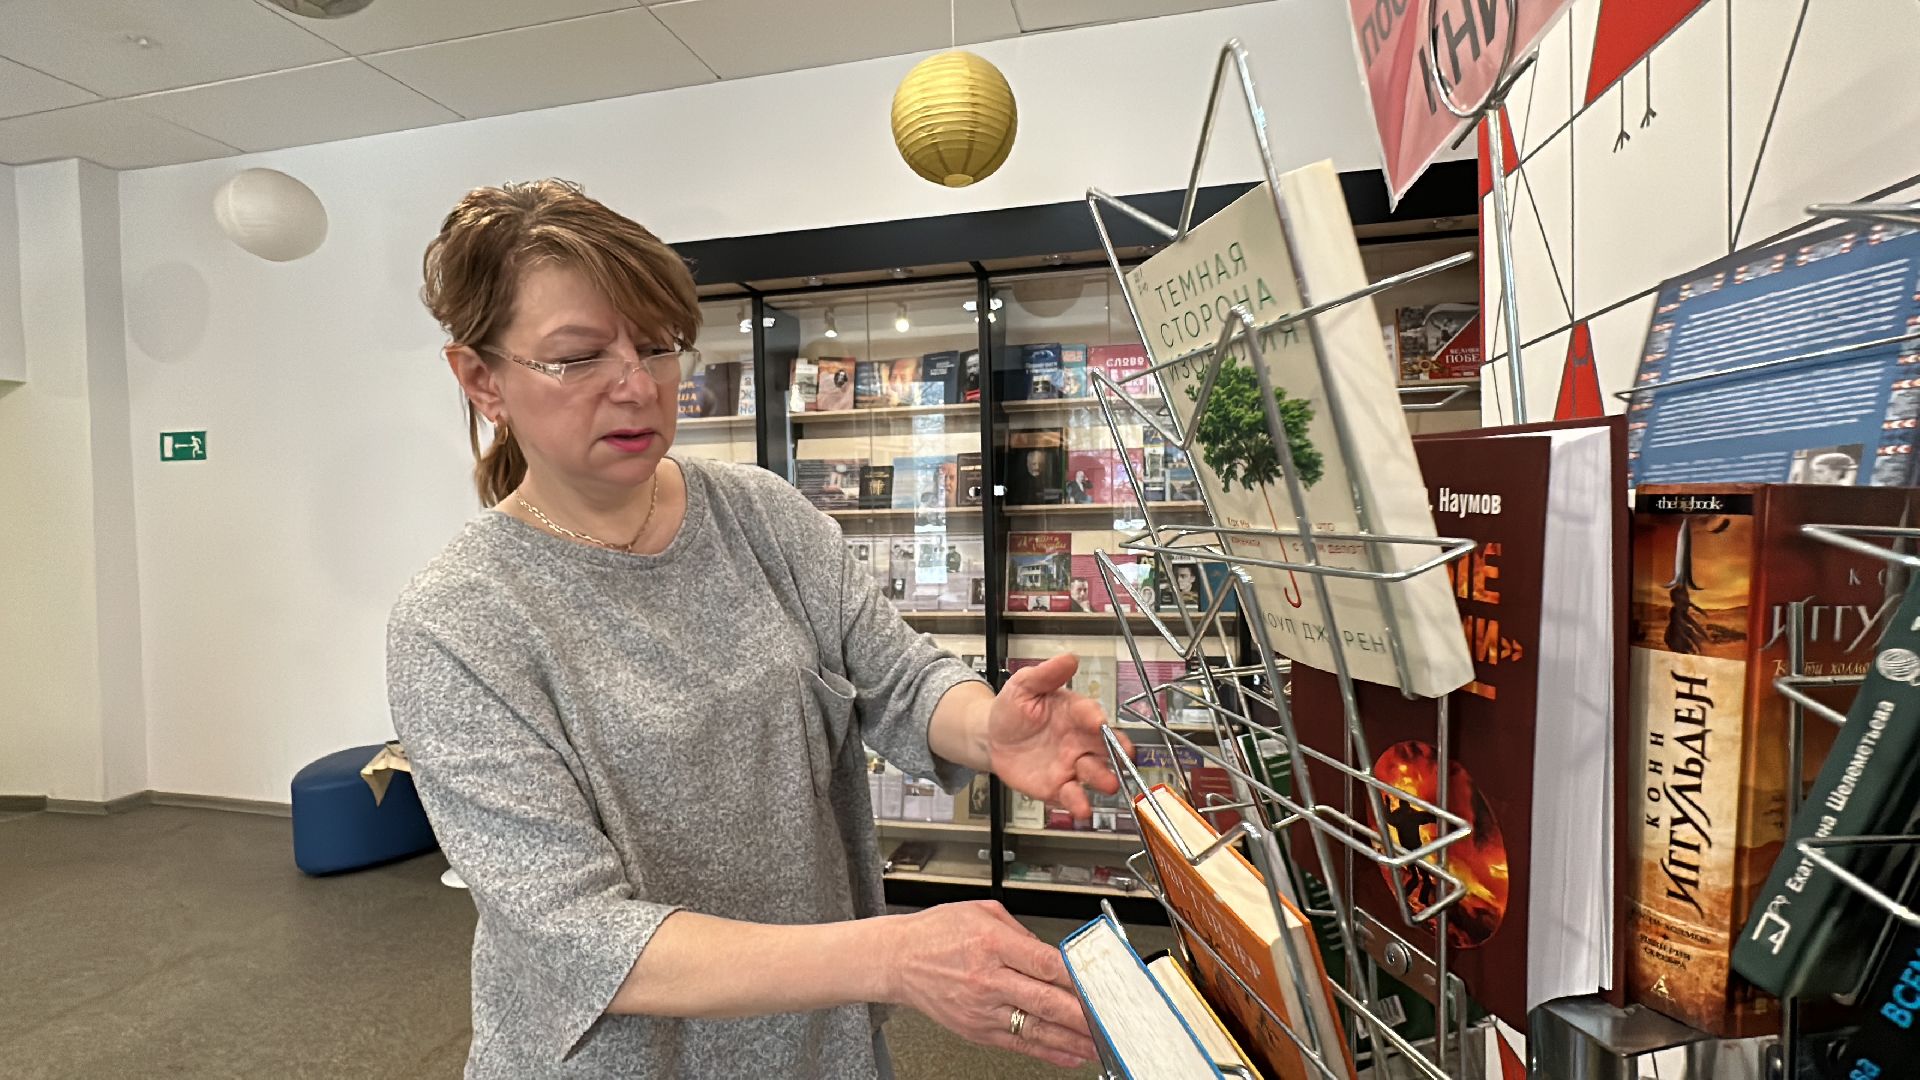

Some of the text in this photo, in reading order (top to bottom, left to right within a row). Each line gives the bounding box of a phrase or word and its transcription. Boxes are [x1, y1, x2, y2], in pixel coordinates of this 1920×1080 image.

[1155, 241, 1248, 312] ТЕМНАЯ
[1160, 277, 1277, 349] СТОРОНА
[1445, 354, 1481, 364] ПОБЕ
[1438, 487, 1503, 519] Наумов
[1263, 611, 1388, 654] ОУП ДЖРЕН
[1645, 731, 1666, 829] КОНН
[1660, 670, 1715, 920] ИГГУЛЬДЕН
